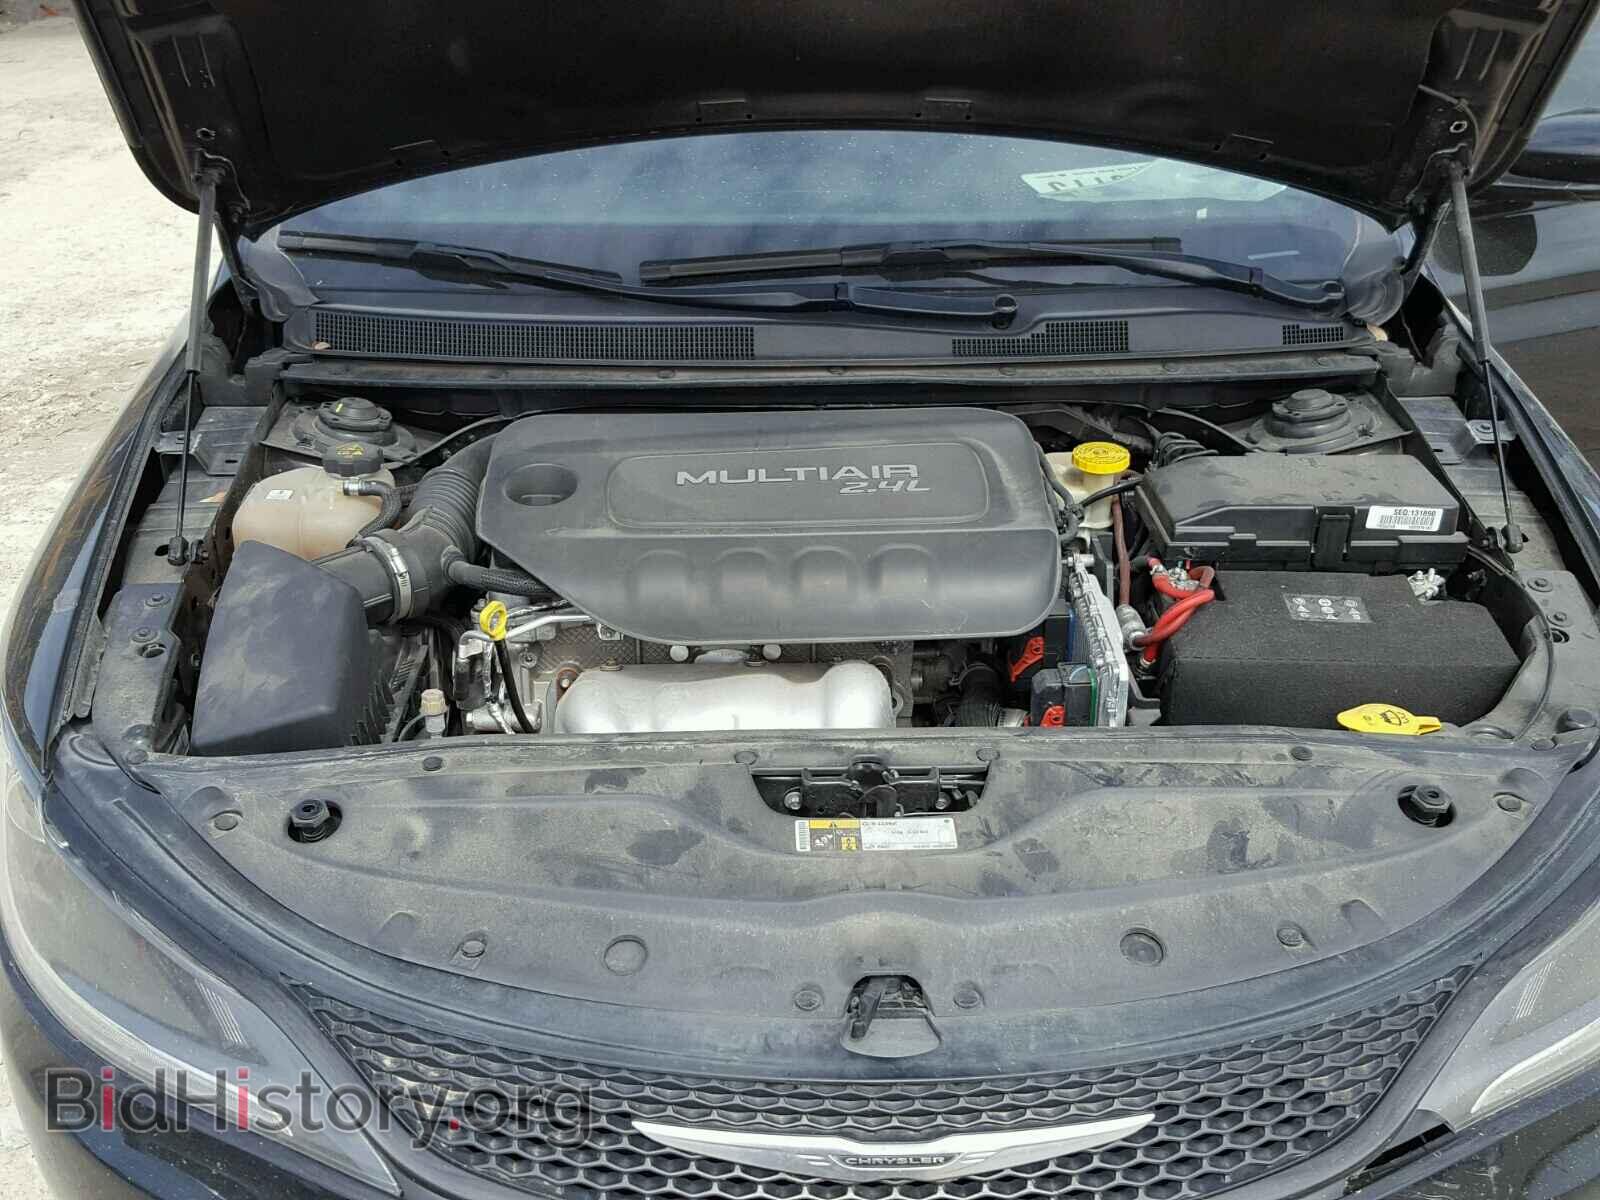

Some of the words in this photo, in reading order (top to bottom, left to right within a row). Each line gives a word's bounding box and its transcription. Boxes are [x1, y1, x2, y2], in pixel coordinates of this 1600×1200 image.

[676, 464, 920, 485] MULTIAIR
[839, 480, 931, 496] 2.4L
[845, 1156, 945, 1165] CHRYSLER
